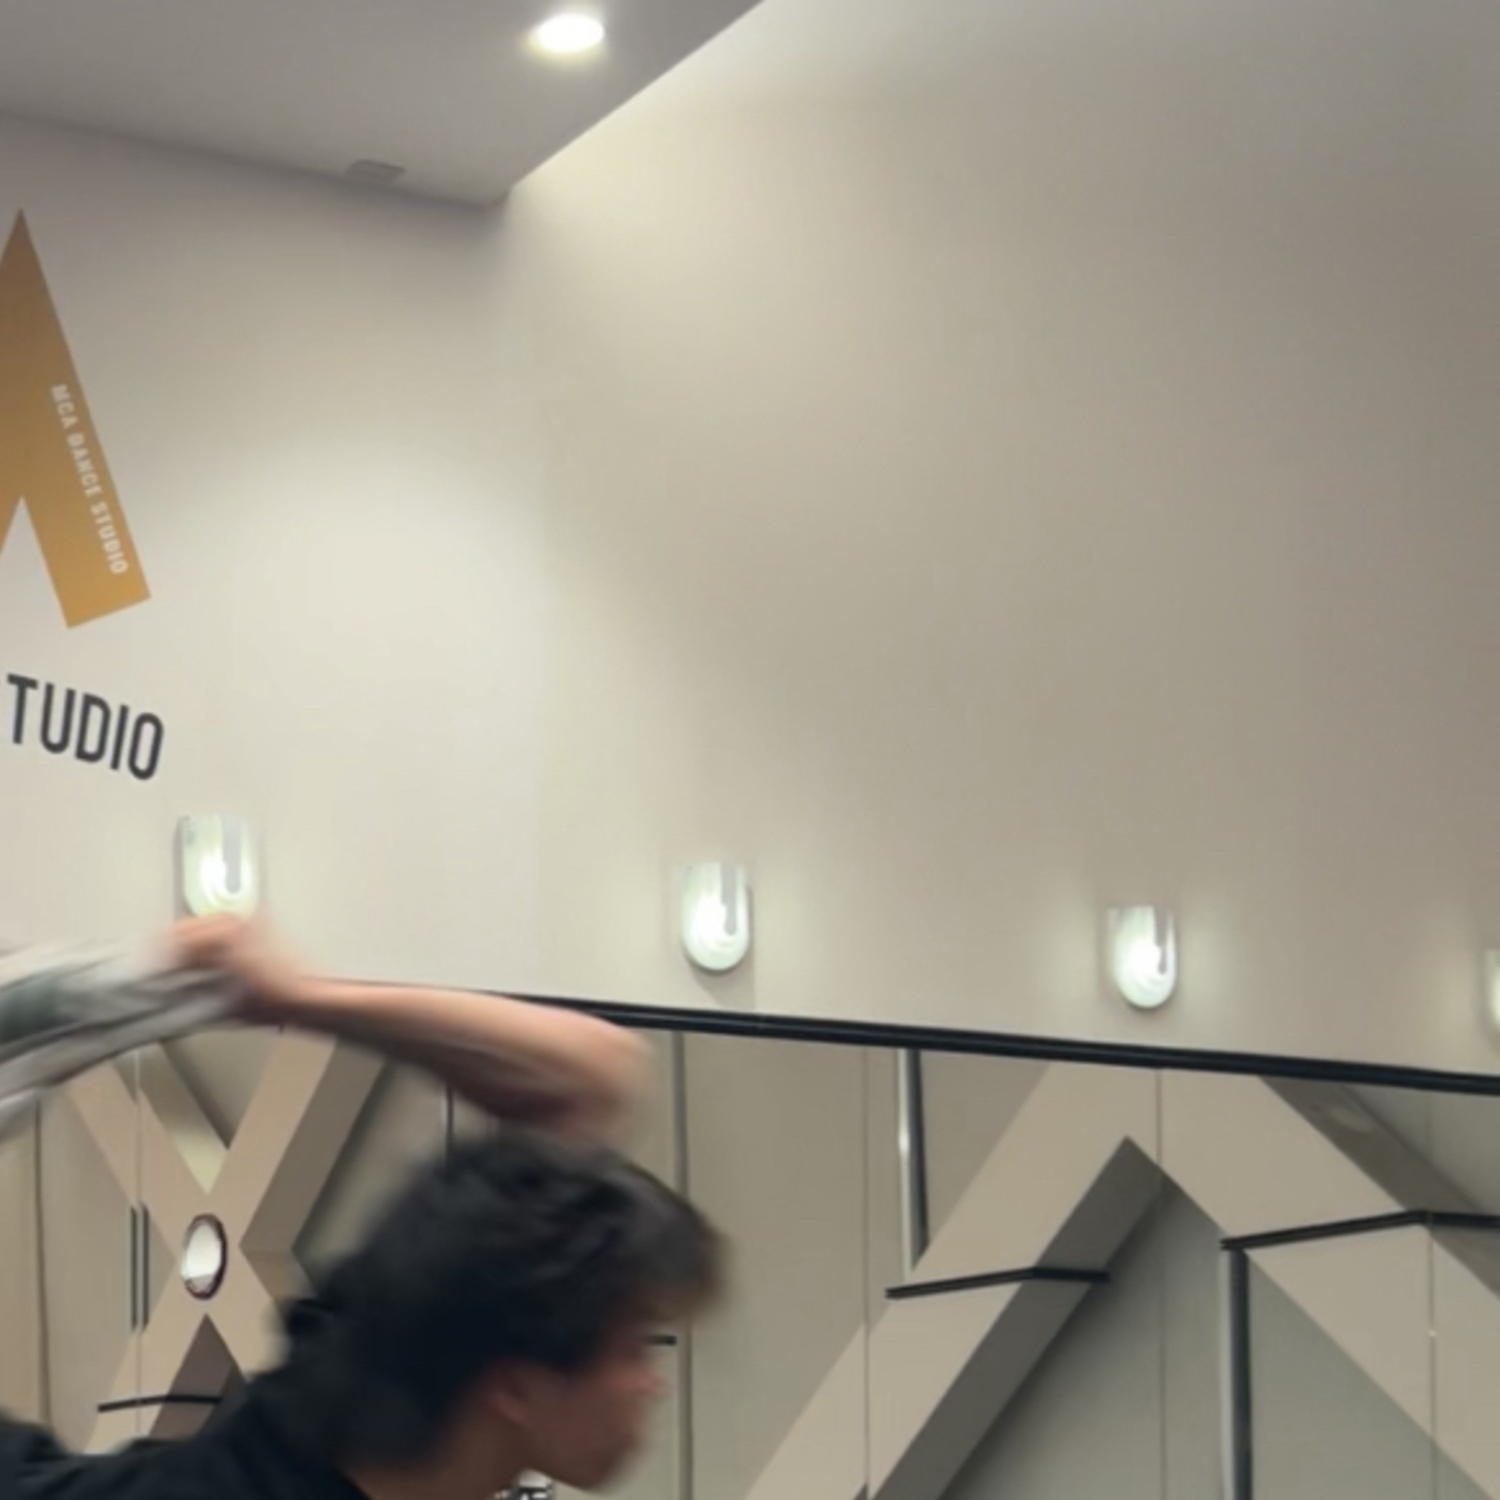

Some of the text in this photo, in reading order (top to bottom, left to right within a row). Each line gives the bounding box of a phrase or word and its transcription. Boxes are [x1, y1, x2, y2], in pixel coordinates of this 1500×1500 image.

[51, 384, 129, 575] MCA DANCE STUDIO
